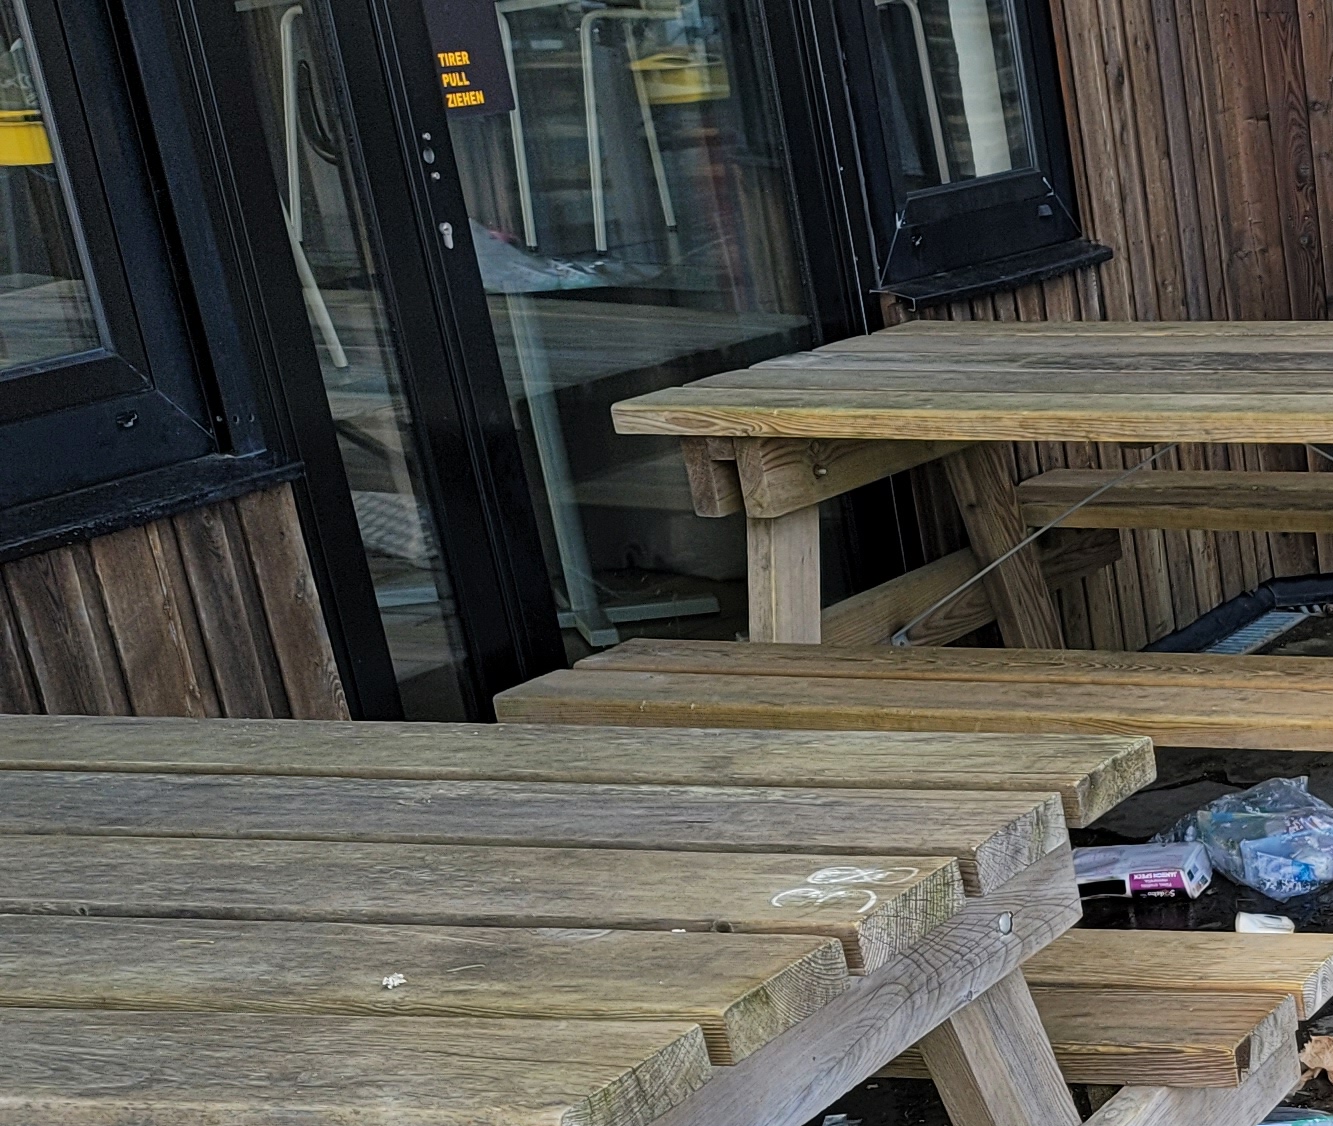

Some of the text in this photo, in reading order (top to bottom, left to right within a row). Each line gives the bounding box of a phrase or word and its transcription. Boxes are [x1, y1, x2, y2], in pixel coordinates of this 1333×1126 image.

[437, 51, 470, 67] TIRER
[441, 71, 470, 87] PULL
[445, 90, 485, 108] ZIEHEN
